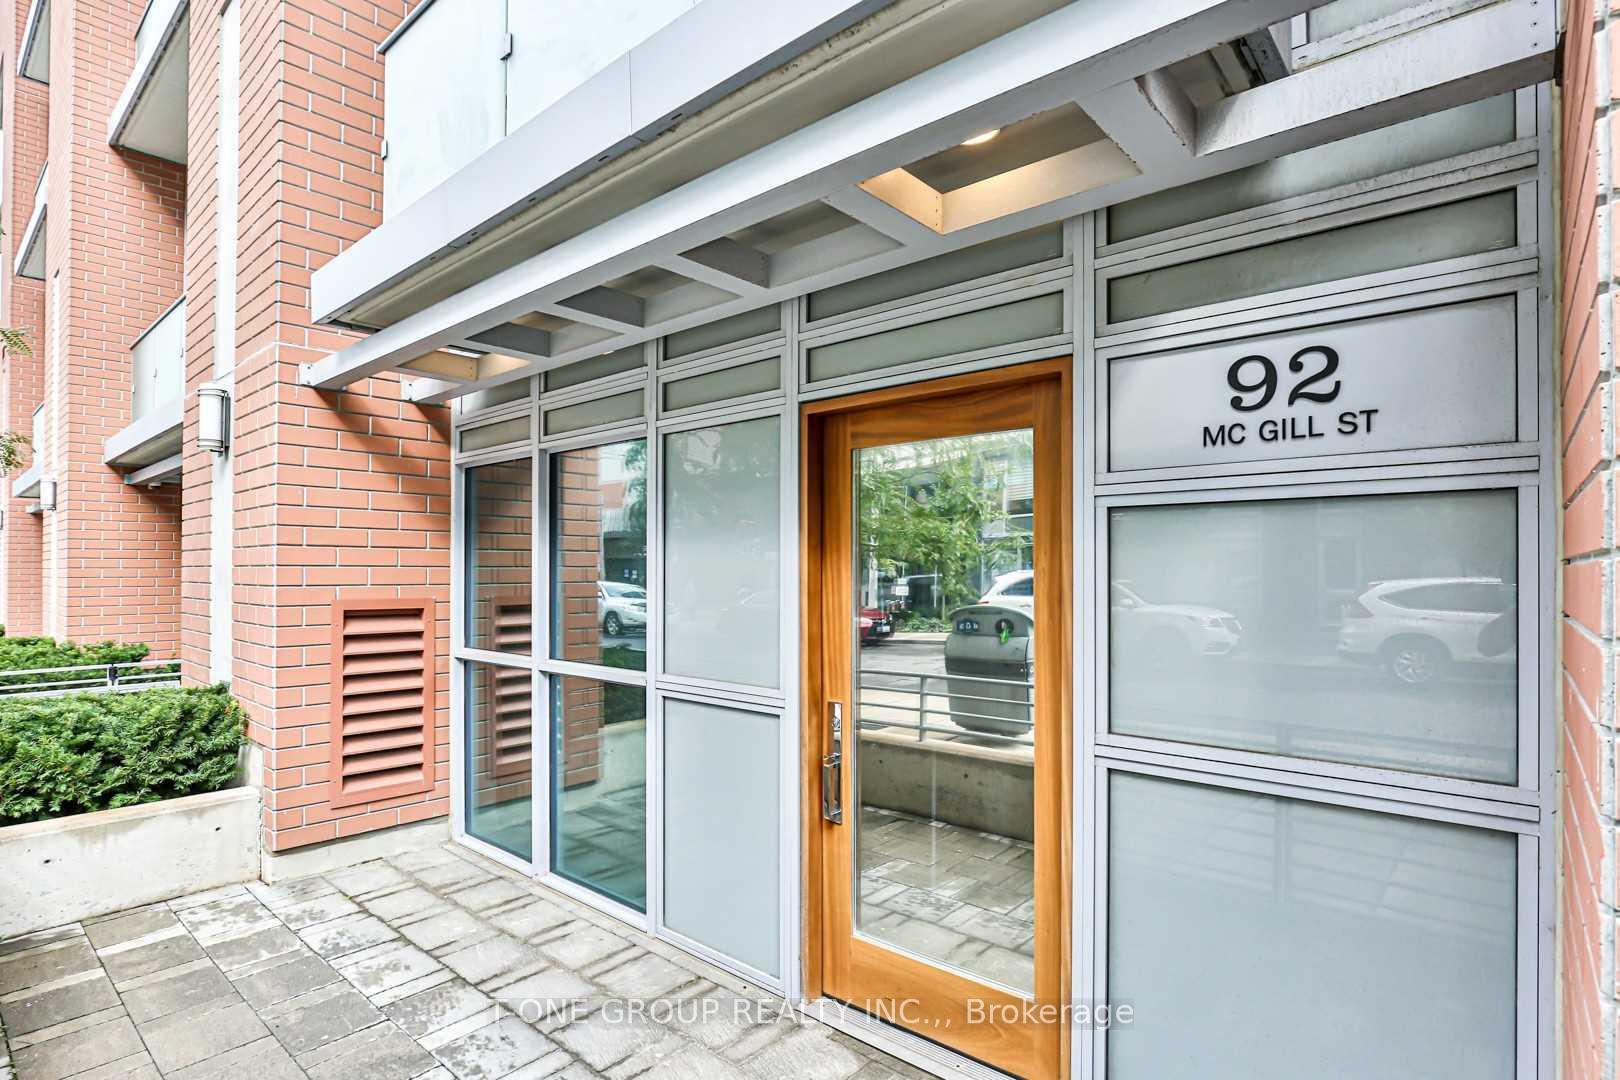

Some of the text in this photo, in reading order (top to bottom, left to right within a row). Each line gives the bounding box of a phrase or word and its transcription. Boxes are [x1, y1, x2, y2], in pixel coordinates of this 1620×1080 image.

[1227, 345, 1341, 412] 92
[1202, 409, 1379, 448] MC GILL ST
